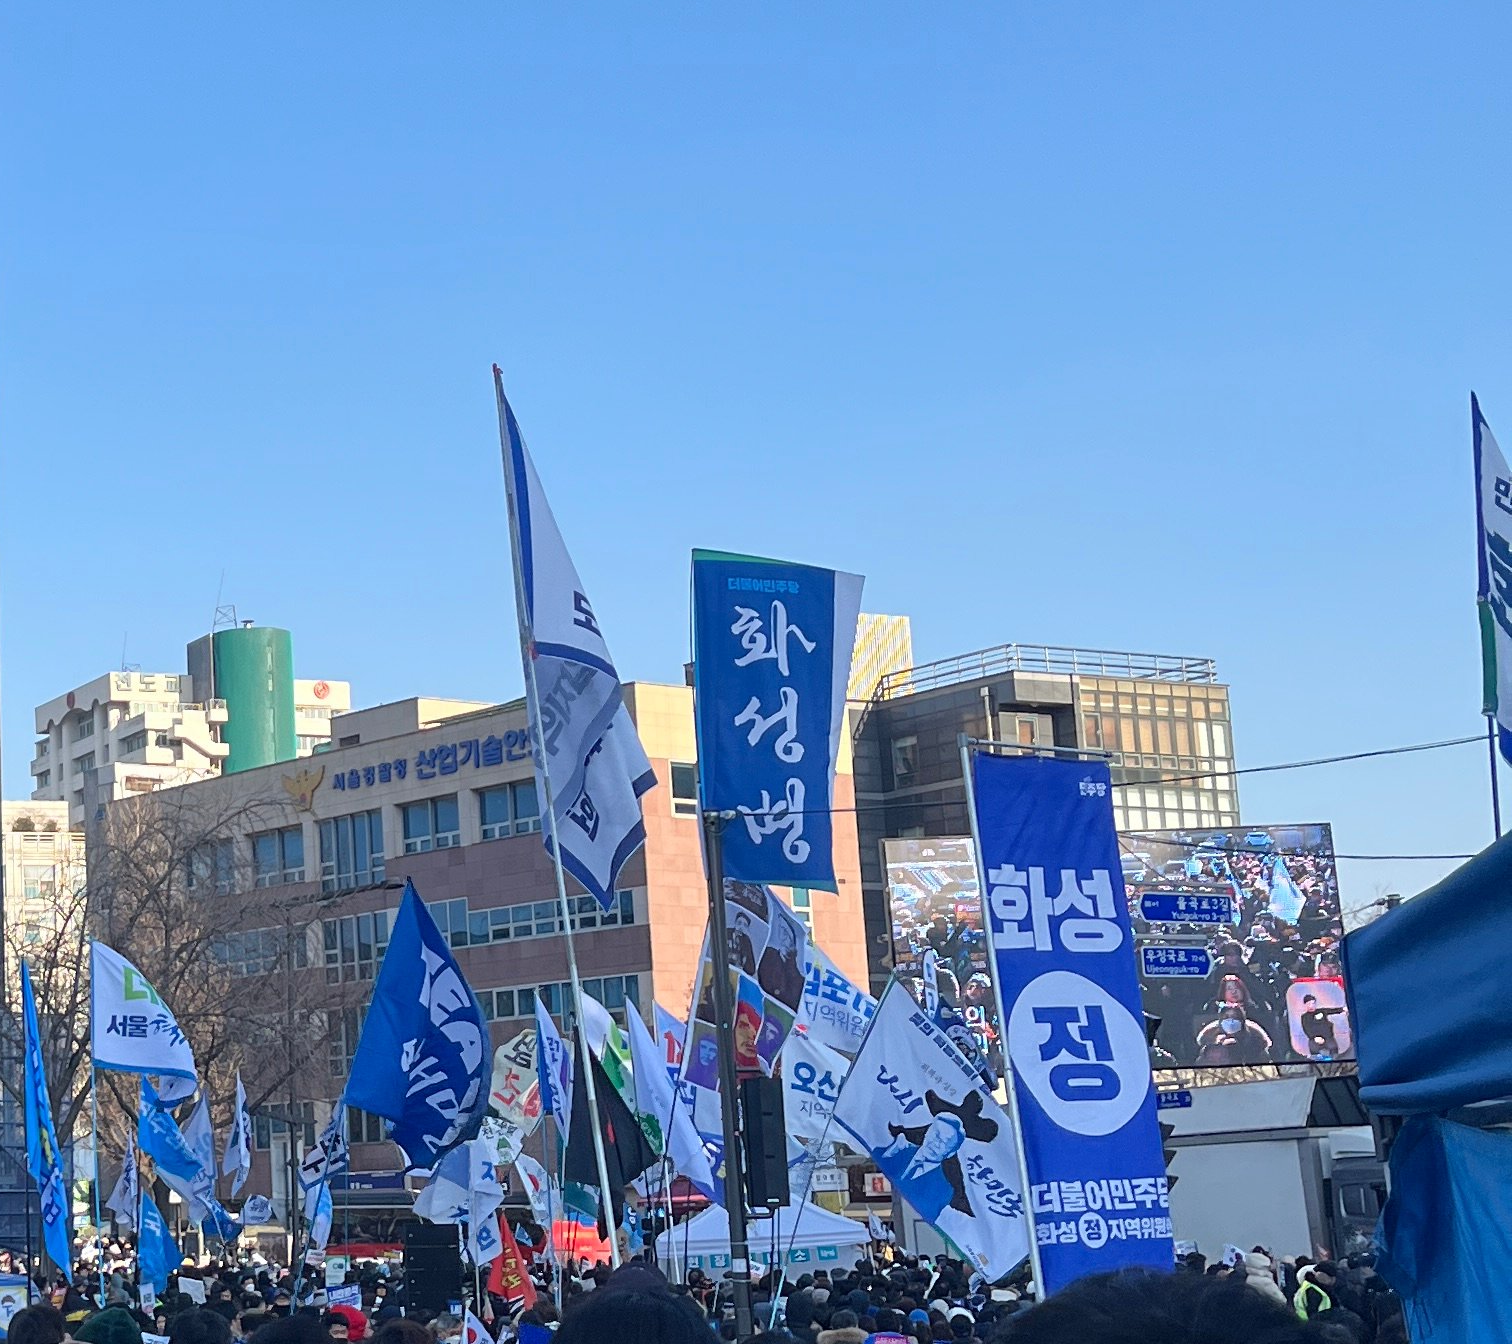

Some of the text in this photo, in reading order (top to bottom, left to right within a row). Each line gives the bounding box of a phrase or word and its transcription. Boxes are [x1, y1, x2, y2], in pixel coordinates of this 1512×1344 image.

[728, 577, 799, 594] 더불어민주당
[332, 728, 533, 791] 서울경찰청 산업기술안
[988, 863, 1124, 953] 화성
[1176, 896, 1229, 912] 율곡로3길
[1145, 949, 1188, 964] 우정국로
[1145, 964, 1201, 975] Ujeongguk-ro
[805, 999, 869, 1040] 지역위원
[1032, 1005, 1121, 1101] 정
[1035, 1219, 1078, 1246] 화성
